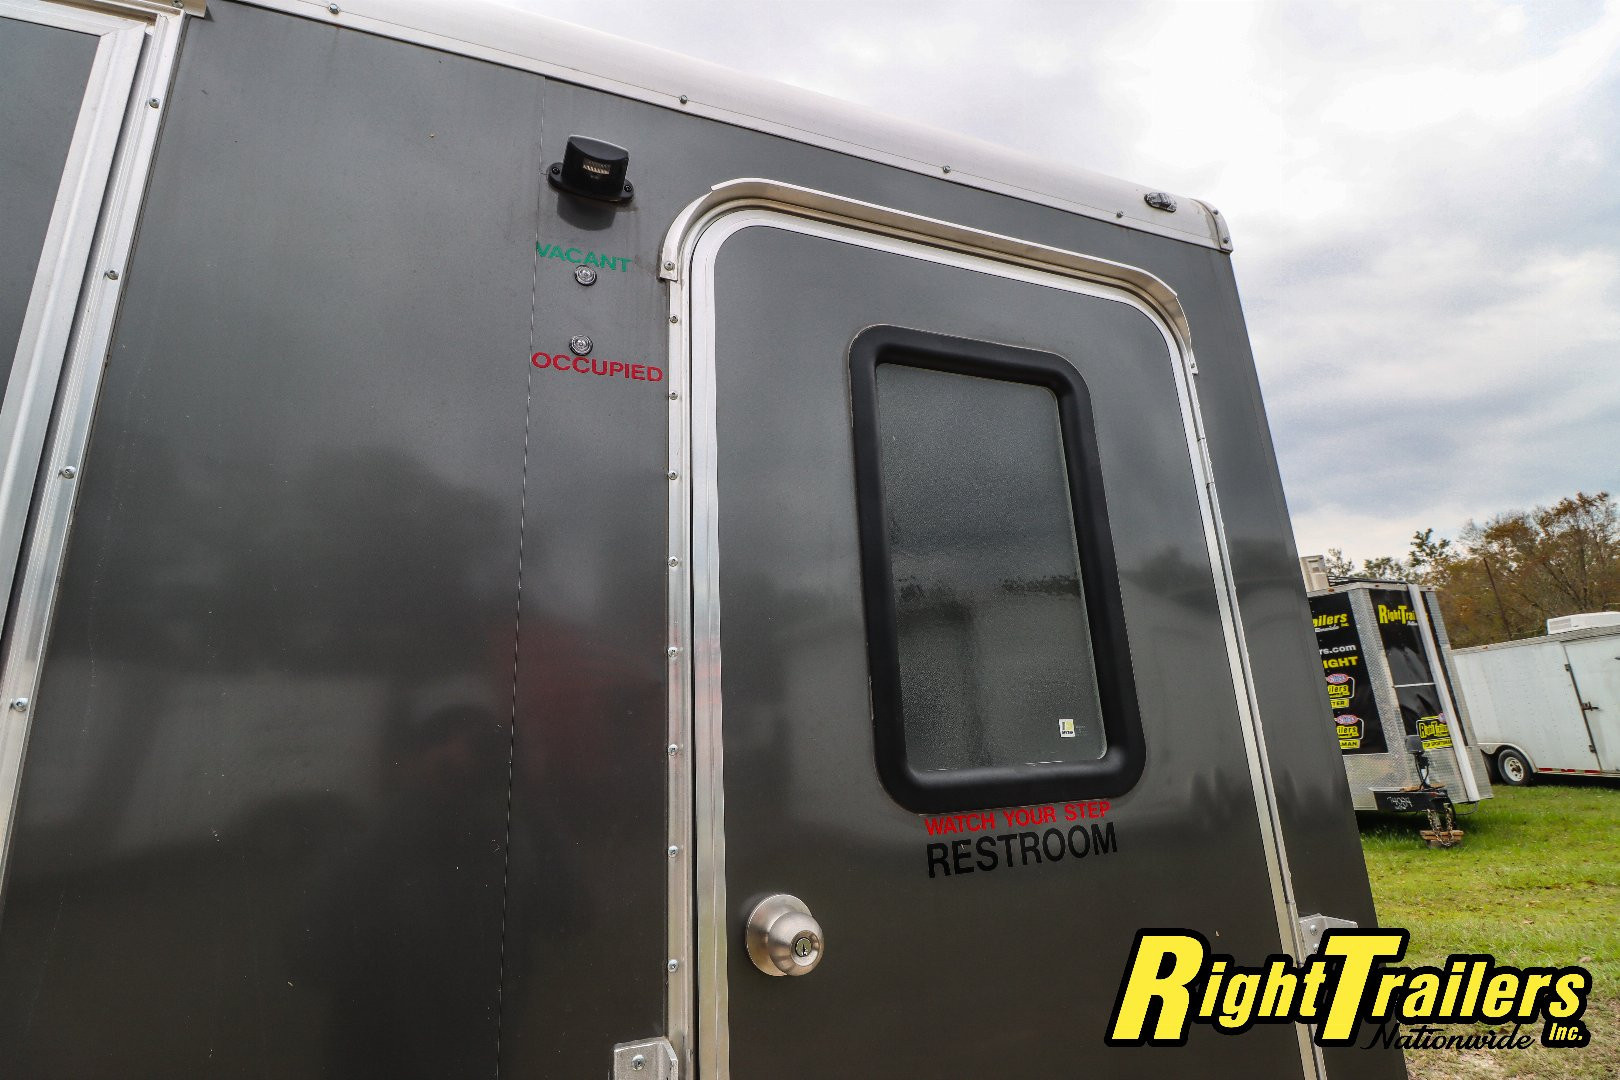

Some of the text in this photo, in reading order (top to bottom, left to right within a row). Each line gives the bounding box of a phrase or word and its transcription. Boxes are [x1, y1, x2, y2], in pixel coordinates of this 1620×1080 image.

[536, 241, 632, 272] VACANT
[531, 351, 664, 382] OCCUPIED
[1319, 644, 1357, 655] rs.com
[1322, 655, 1359, 669] IGHT
[924, 801, 1112, 836] WATCH YOUR STEP
[926, 821, 1118, 879] RESTROOM
